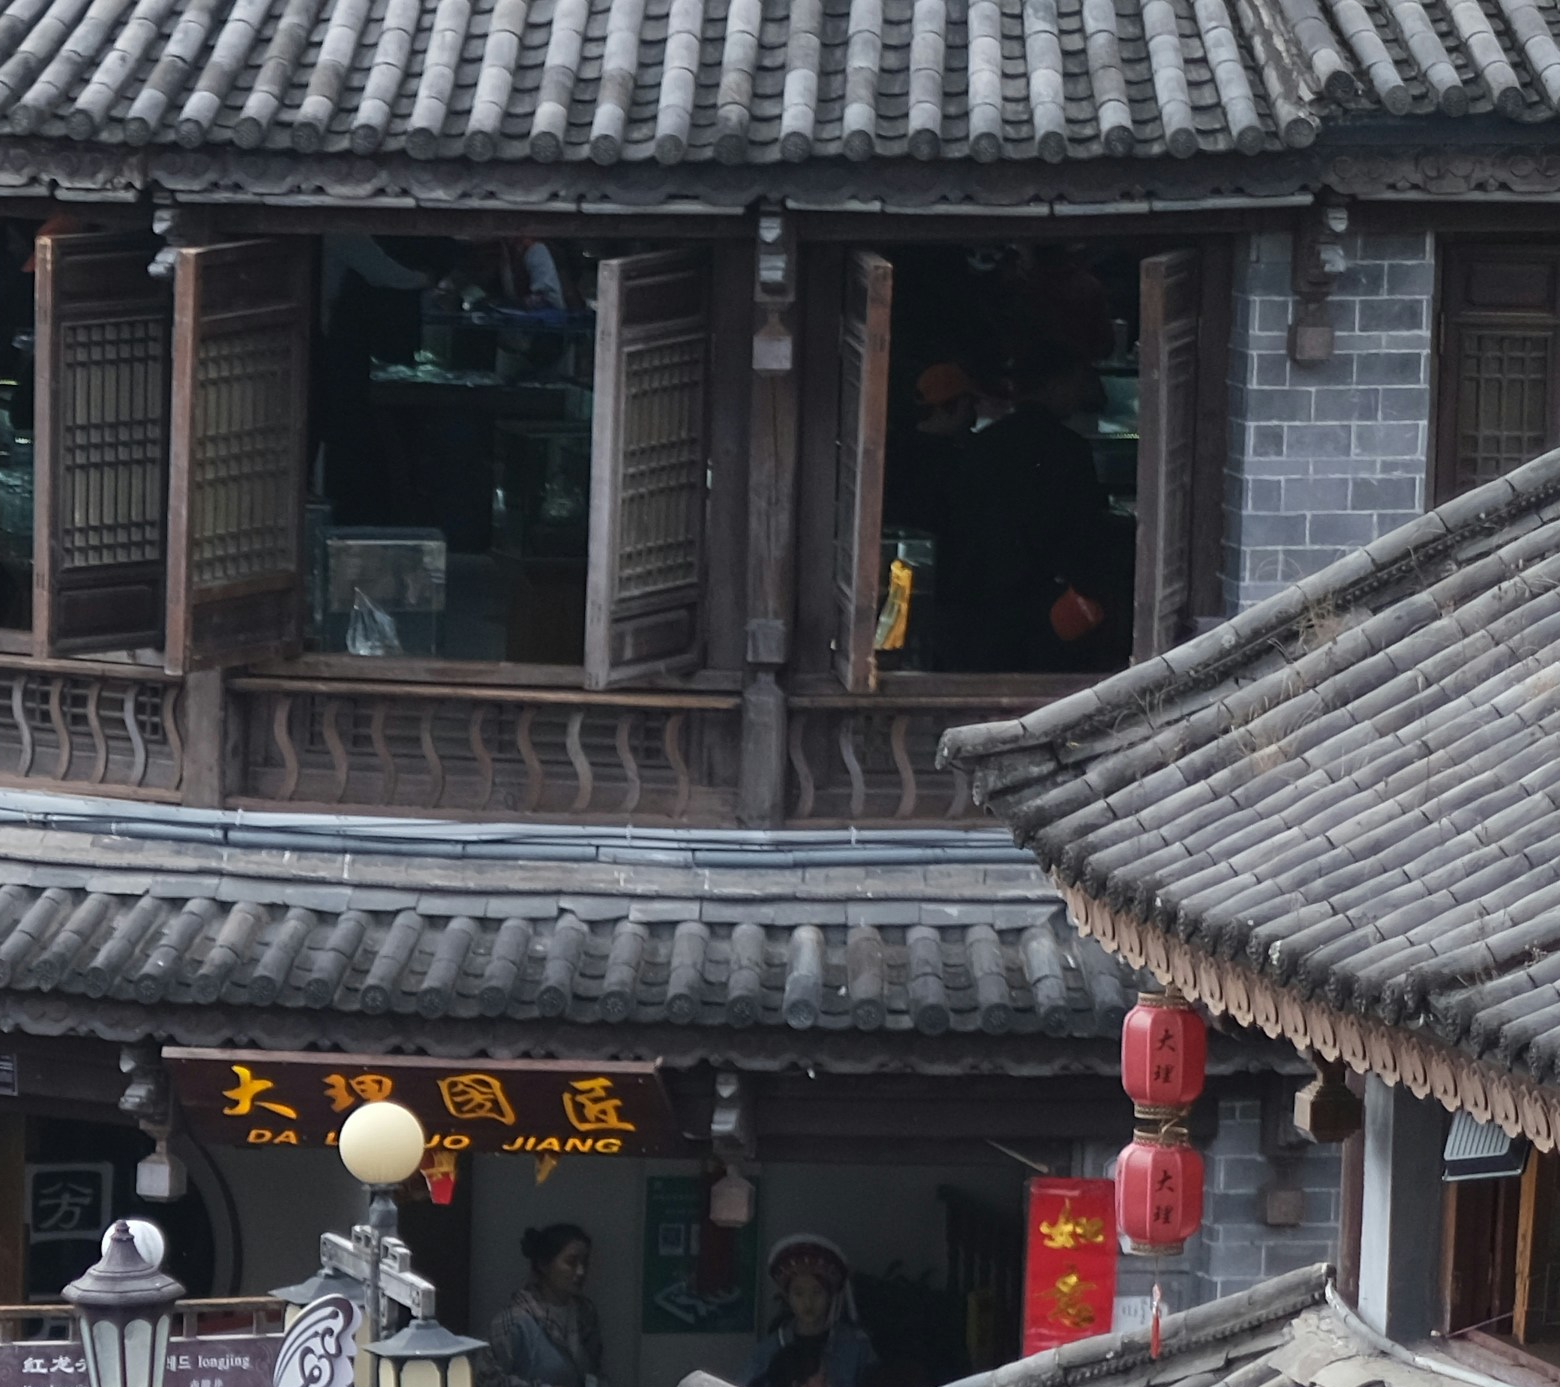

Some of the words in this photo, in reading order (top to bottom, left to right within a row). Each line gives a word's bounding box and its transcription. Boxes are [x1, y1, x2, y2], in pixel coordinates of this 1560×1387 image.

[1153, 1028, 1175, 1085] 大理
[247, 1129, 297, 1145] DA
[424, 1134, 471, 1151] UO
[502, 1136, 623, 1154] JIANG
[1153, 1169, 1175, 1225] 大理
[198, 1354, 251, 1371] longjing
